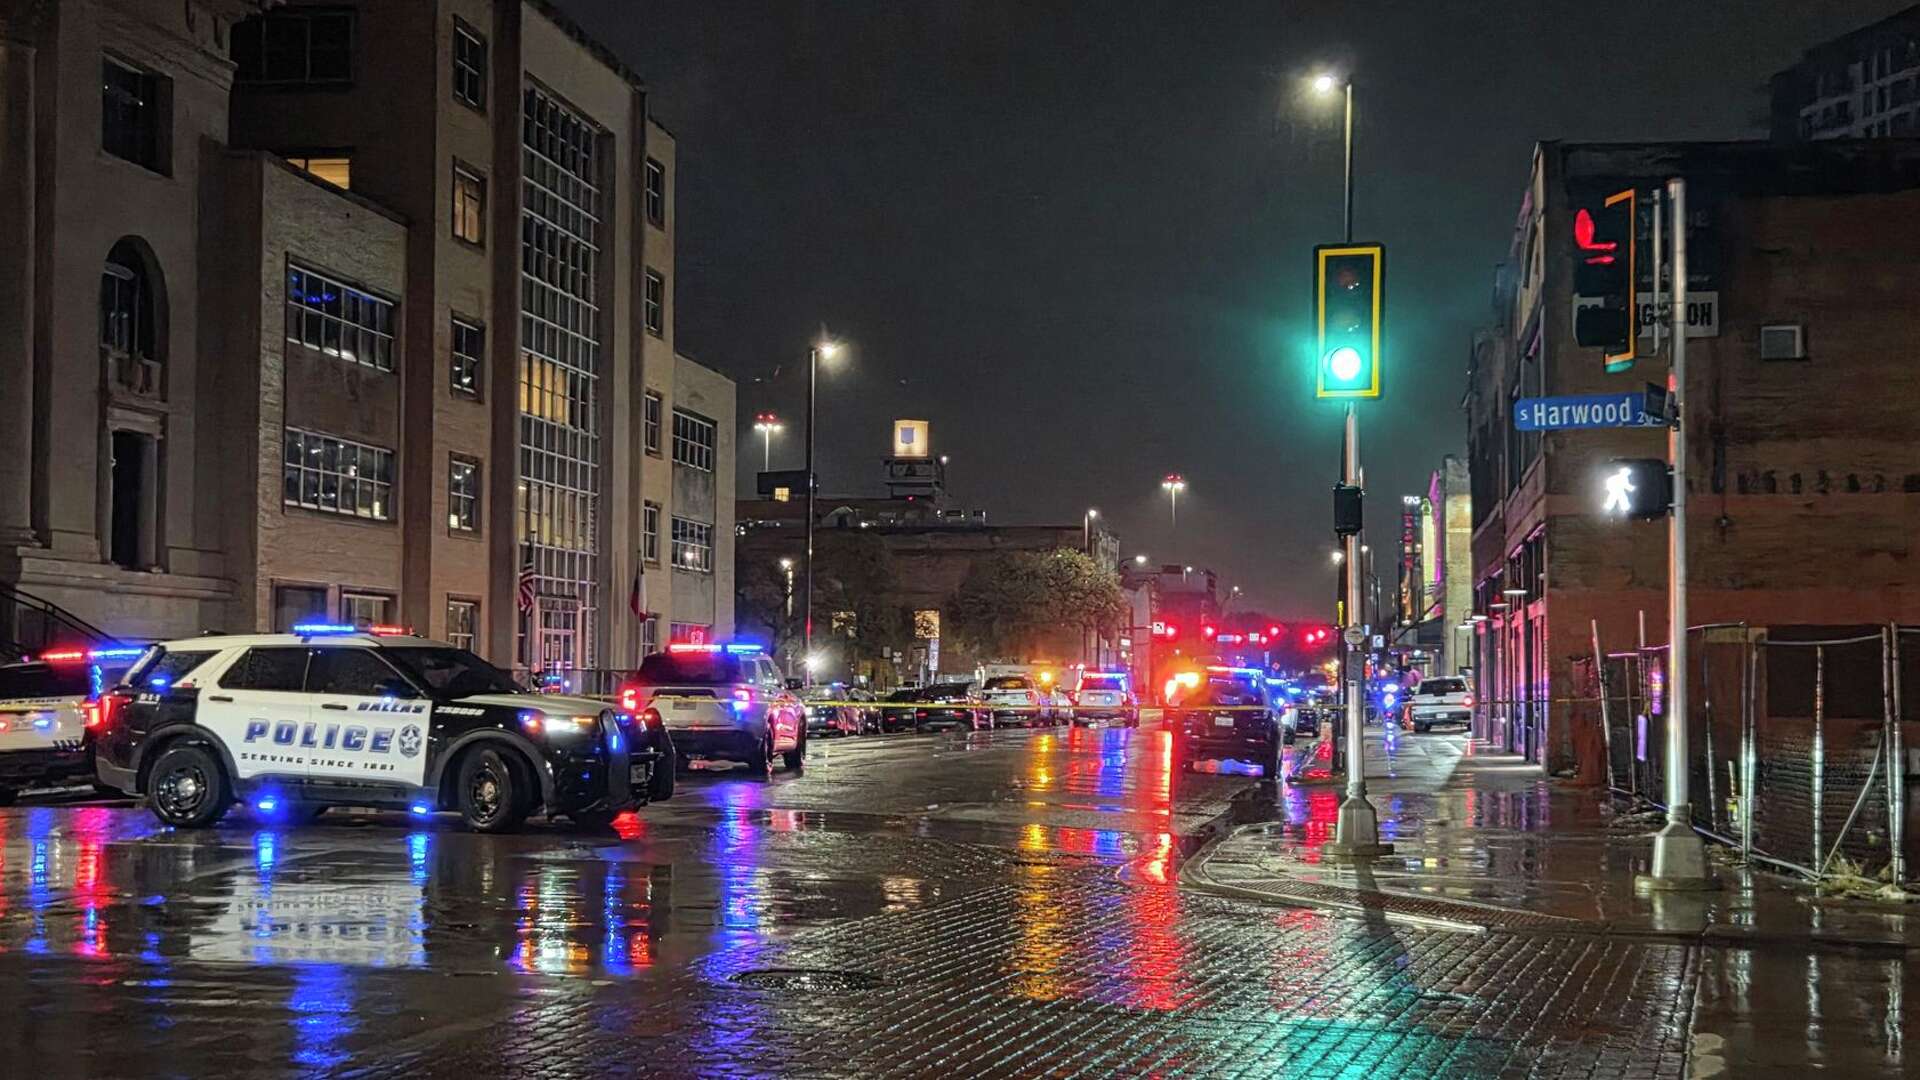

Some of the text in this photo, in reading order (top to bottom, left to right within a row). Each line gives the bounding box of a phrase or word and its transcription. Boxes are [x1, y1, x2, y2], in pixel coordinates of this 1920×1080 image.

[1520, 408, 1528, 421] S
[1533, 397, 1631, 426] Harwood
[357, 702, 426, 714] DALLAS
[243, 717, 396, 754] POLICE
[240, 752, 304, 764] SERVING
[311, 758, 355, 768] SINCE
